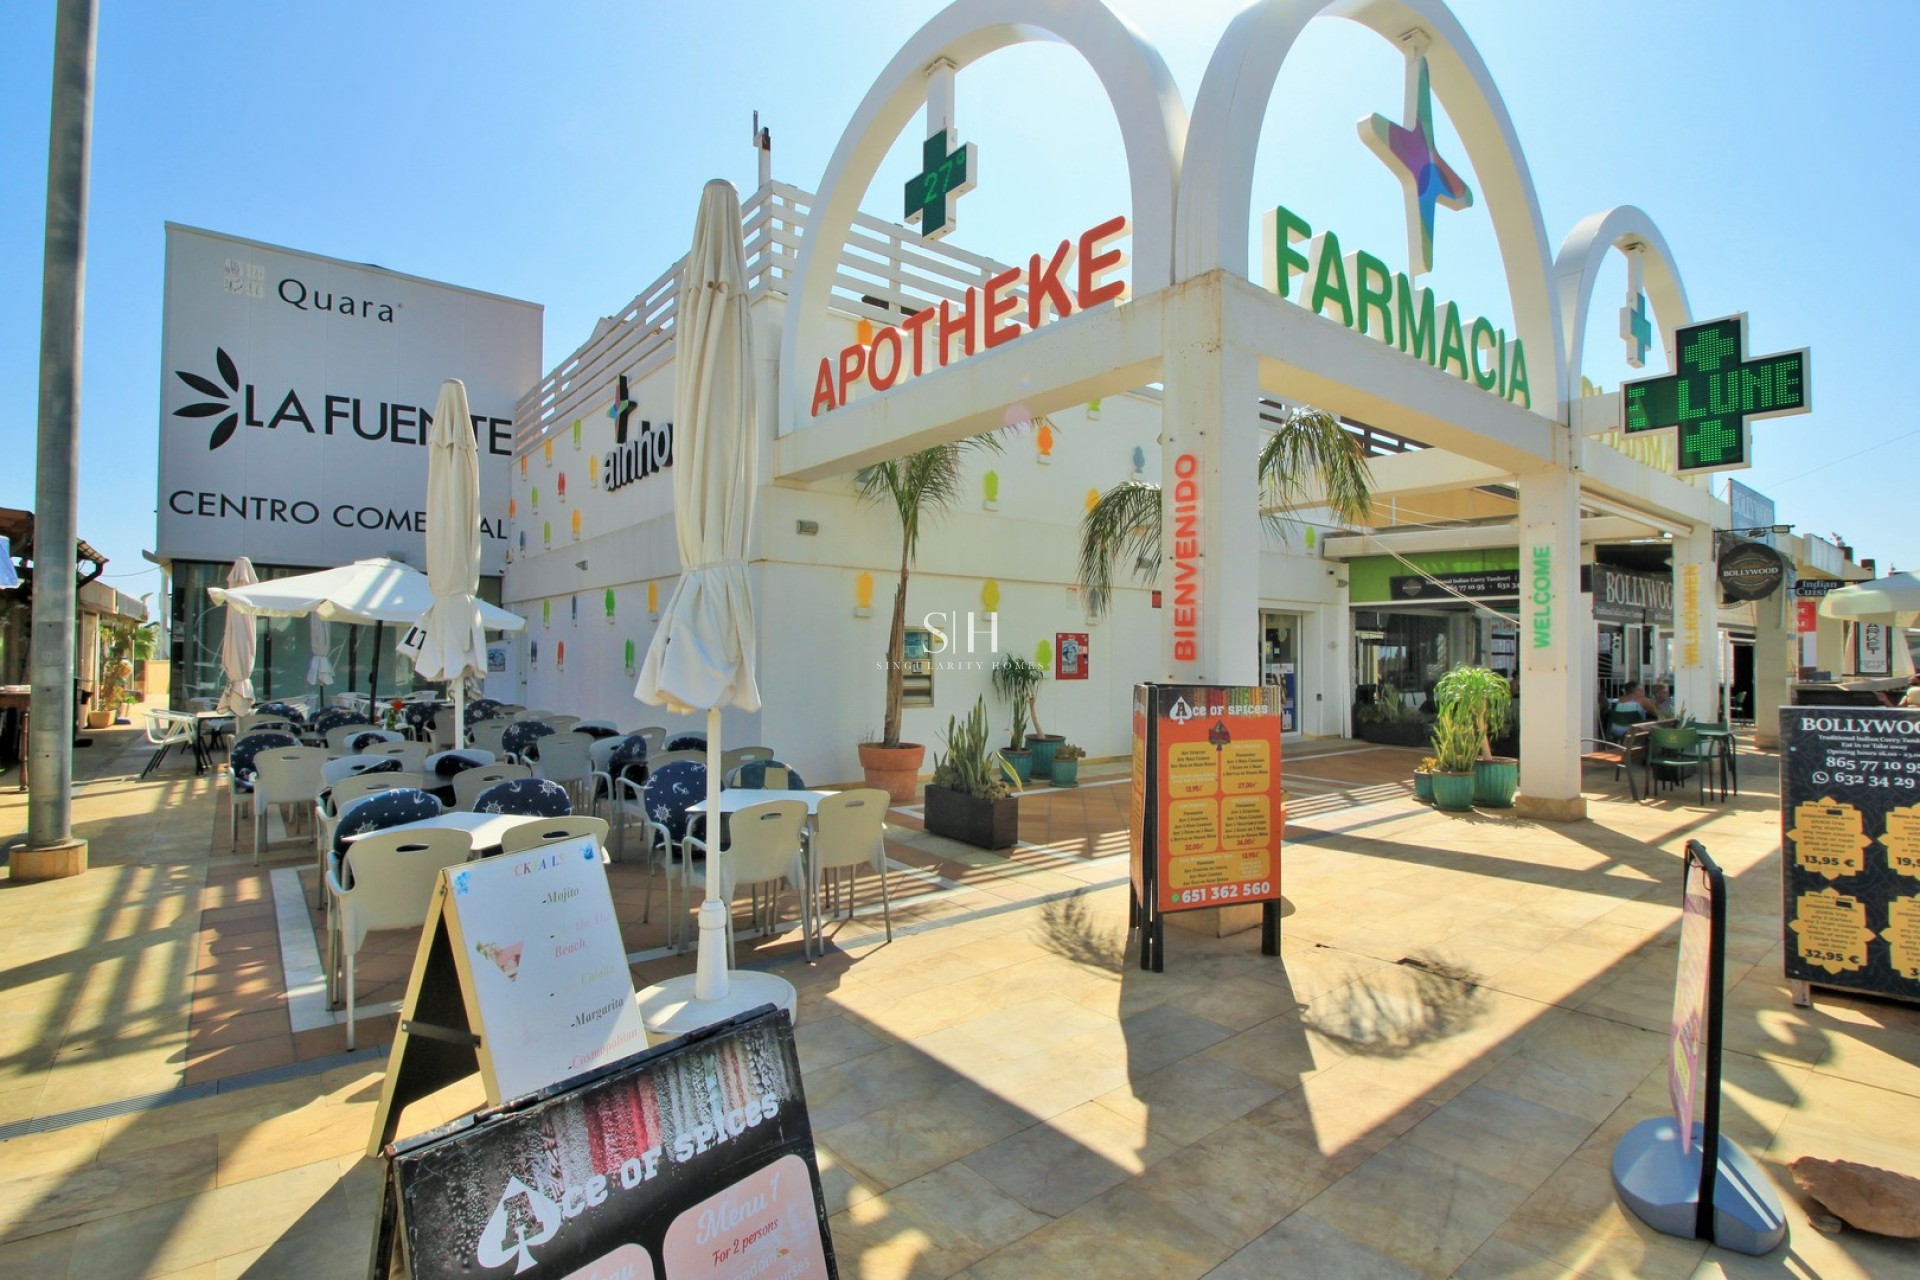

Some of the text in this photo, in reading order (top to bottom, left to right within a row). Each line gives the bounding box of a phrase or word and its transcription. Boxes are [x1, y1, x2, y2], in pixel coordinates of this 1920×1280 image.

[278, 278, 394, 323] Quara
[810, 214, 1128, 418] APOTHEKE
[1273, 204, 1532, 411] FARMACIA
[244, 384, 316, 435] LA
[602, 420, 674, 493] ainho
[168, 488, 509, 541] CENTRO COMEAL
[1174, 454, 1198, 661] BIENVENIDO
[1723, 567, 1779, 577] BOLLYWOOD
[1533, 545, 1551, 649] WELCOME
[1606, 571, 1673, 610] BOLLYWOO
[1796, 587, 1826, 596] Cuisi
[1802, 580, 1838, 588] Indian
[1826, 756, 1856, 770] 865
[1860, 760, 1879, 772] 77
[1883, 761, 1902, 770] 10
[1834, 772, 1915, 789] 632 34 29
[1182, 881, 1270, 903] 651 362 560
[1805, 948, 1844, 962] 32,95
[695, 1193, 768, 1246] Menu
[712, 1217, 779, 1267] For 2 persons
